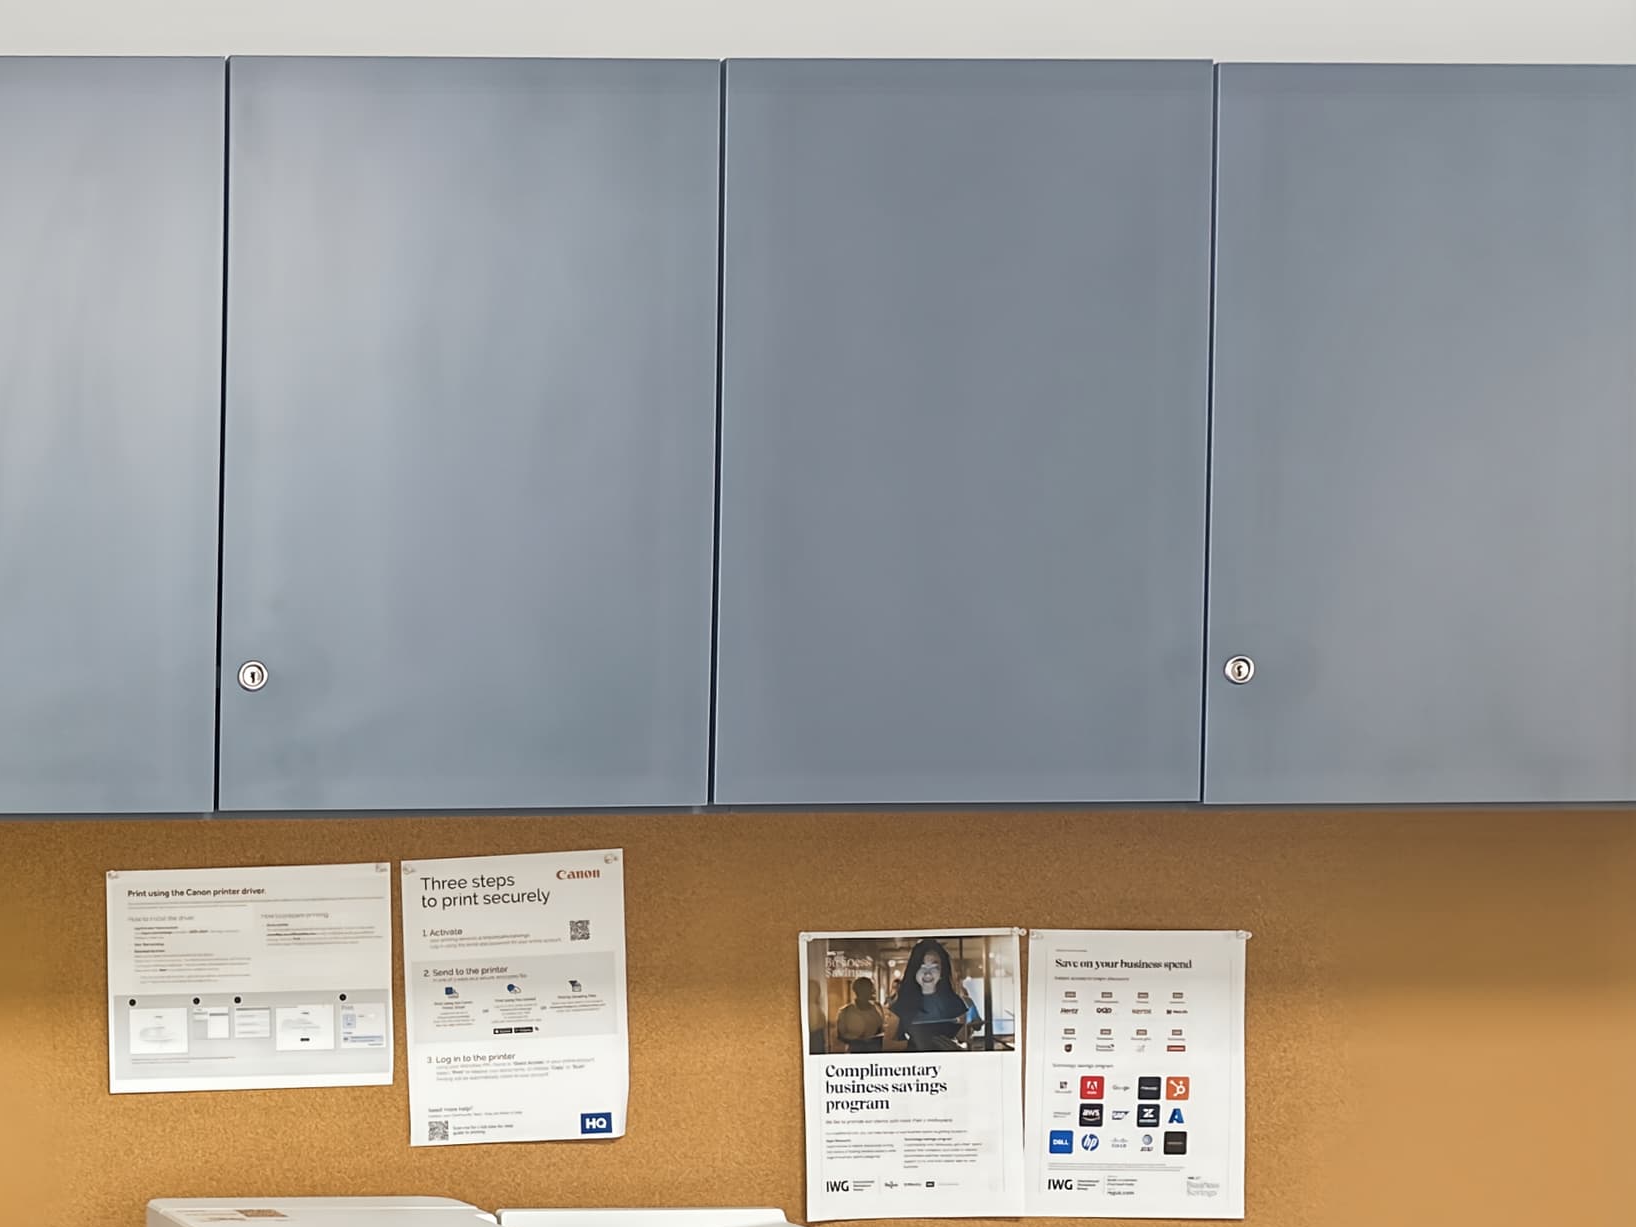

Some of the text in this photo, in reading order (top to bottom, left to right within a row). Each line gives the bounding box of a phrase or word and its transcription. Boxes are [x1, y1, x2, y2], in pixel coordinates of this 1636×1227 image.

[556, 870, 600, 880] Canon
[420, 875, 515, 891] Three steps
[213, 888, 240, 897] printer
[422, 889, 550, 910] to print securely
[429, 928, 463, 936] Activate
[1055, 959, 1078, 968] Save
[1094, 961, 1119, 970] your
[1120, 959, 1162, 968] business
[1164, 960, 1192, 971] spend
[432, 968, 454, 976] Send
[481, 966, 510, 976] printer
[436, 1056, 452, 1064] Log
[473, 1054, 487, 1063] the
[488, 1053, 517, 1063] printer
[825, 1064, 941, 1080] Complimentary
[826, 1079, 947, 1095] business savings
[826, 1100, 889, 1114] program
[585, 1118, 607, 1129] HQ
[826, 1180, 849, 1192] IWG
[1048, 1179, 1073, 1190] IWG
